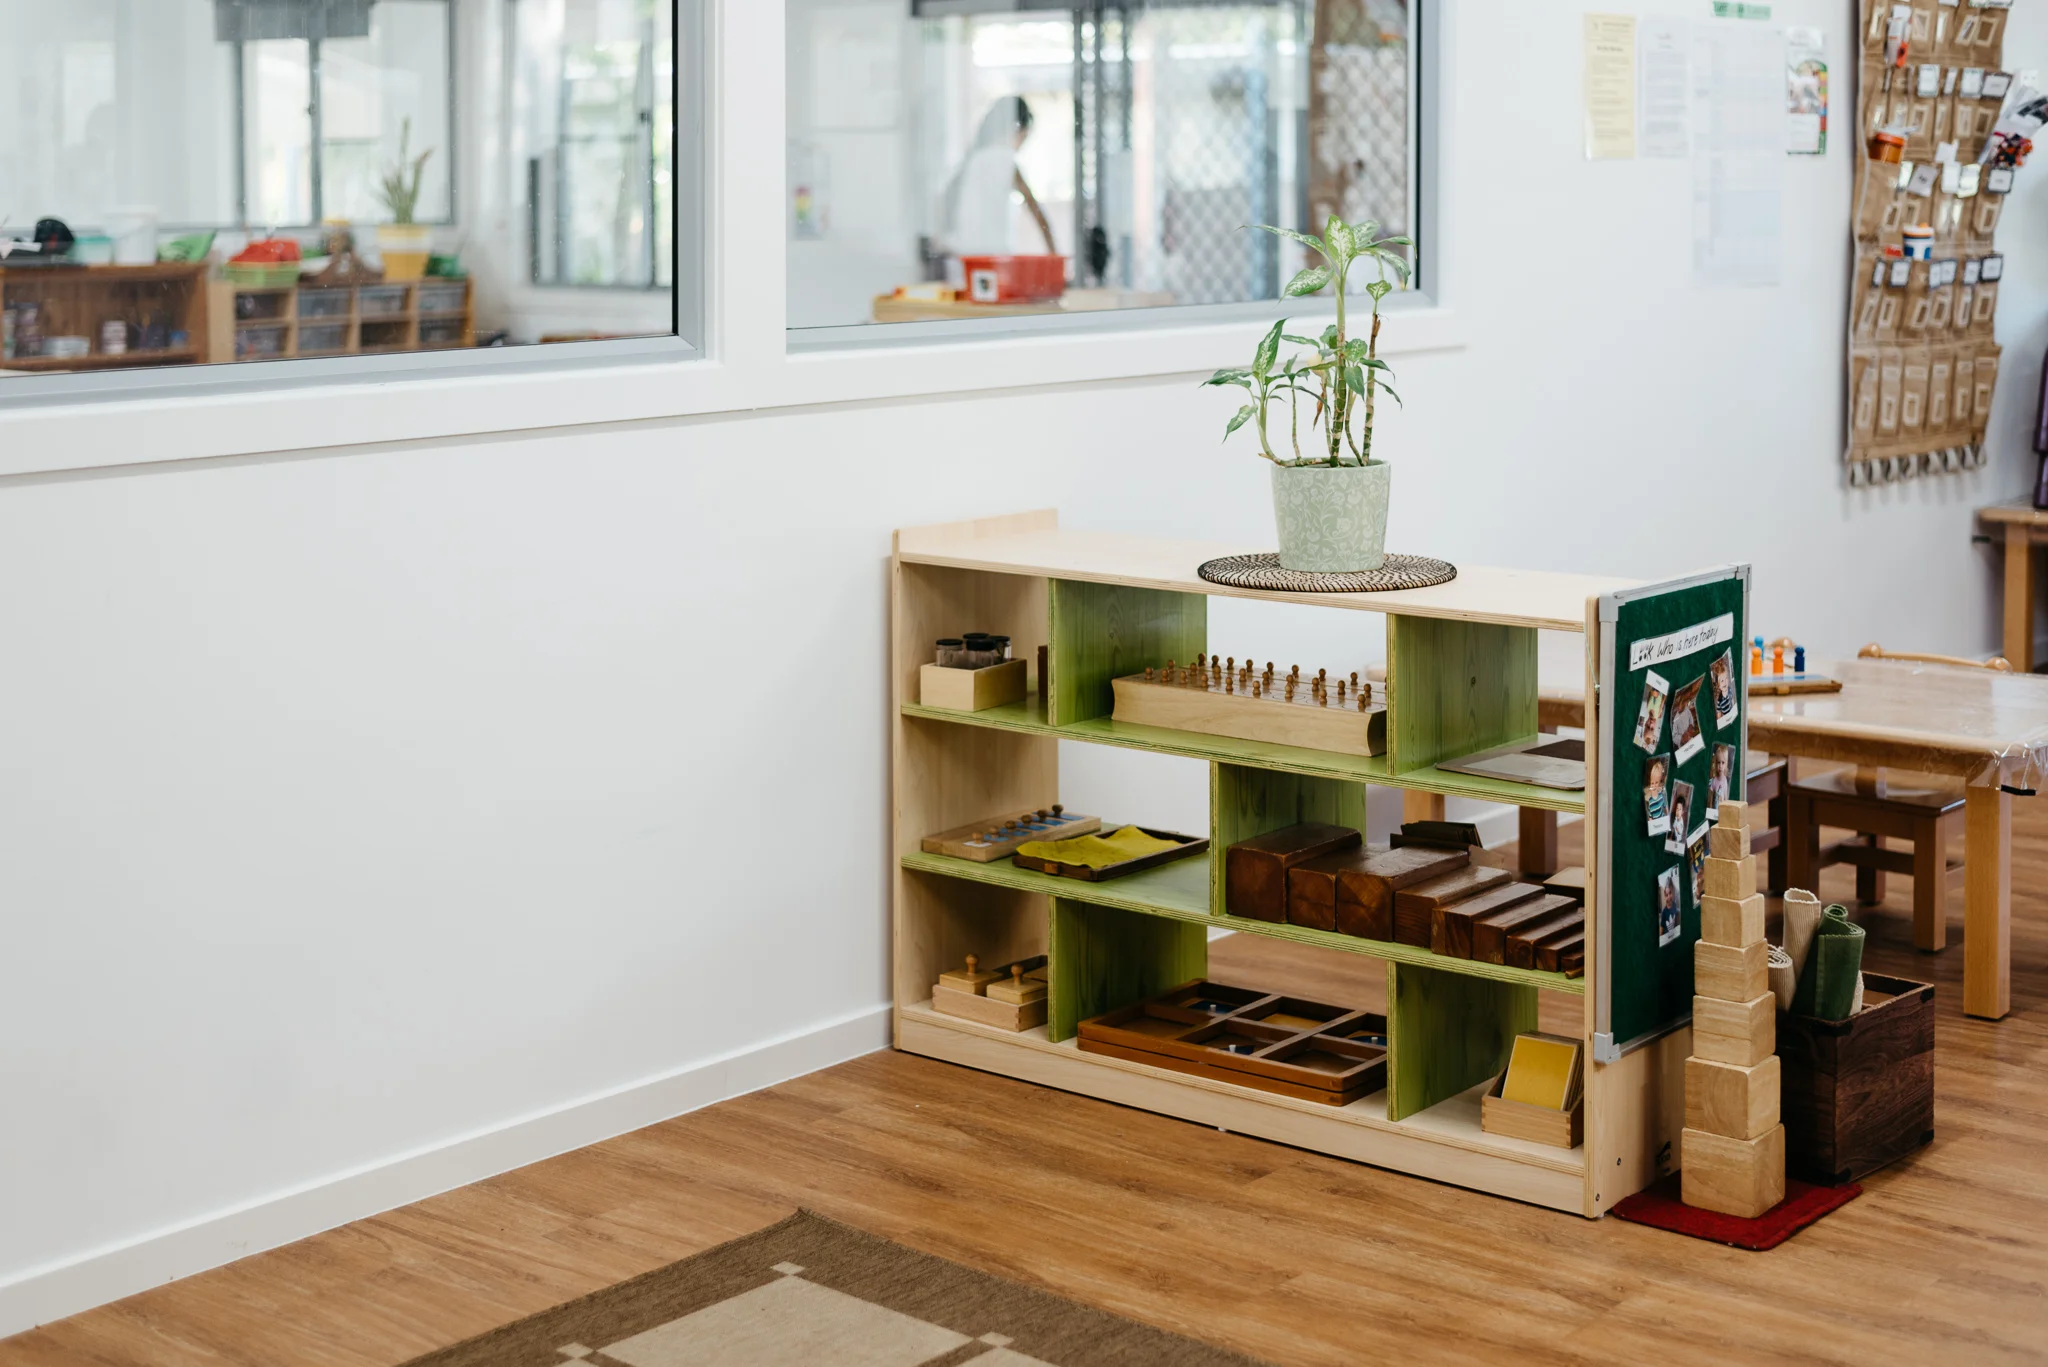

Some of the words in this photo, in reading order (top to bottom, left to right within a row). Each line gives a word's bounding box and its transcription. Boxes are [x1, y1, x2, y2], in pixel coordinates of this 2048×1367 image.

[1676, 639, 1682, 651] is
[1683, 633, 1698, 649] here
[1699, 626, 1719, 644] today
